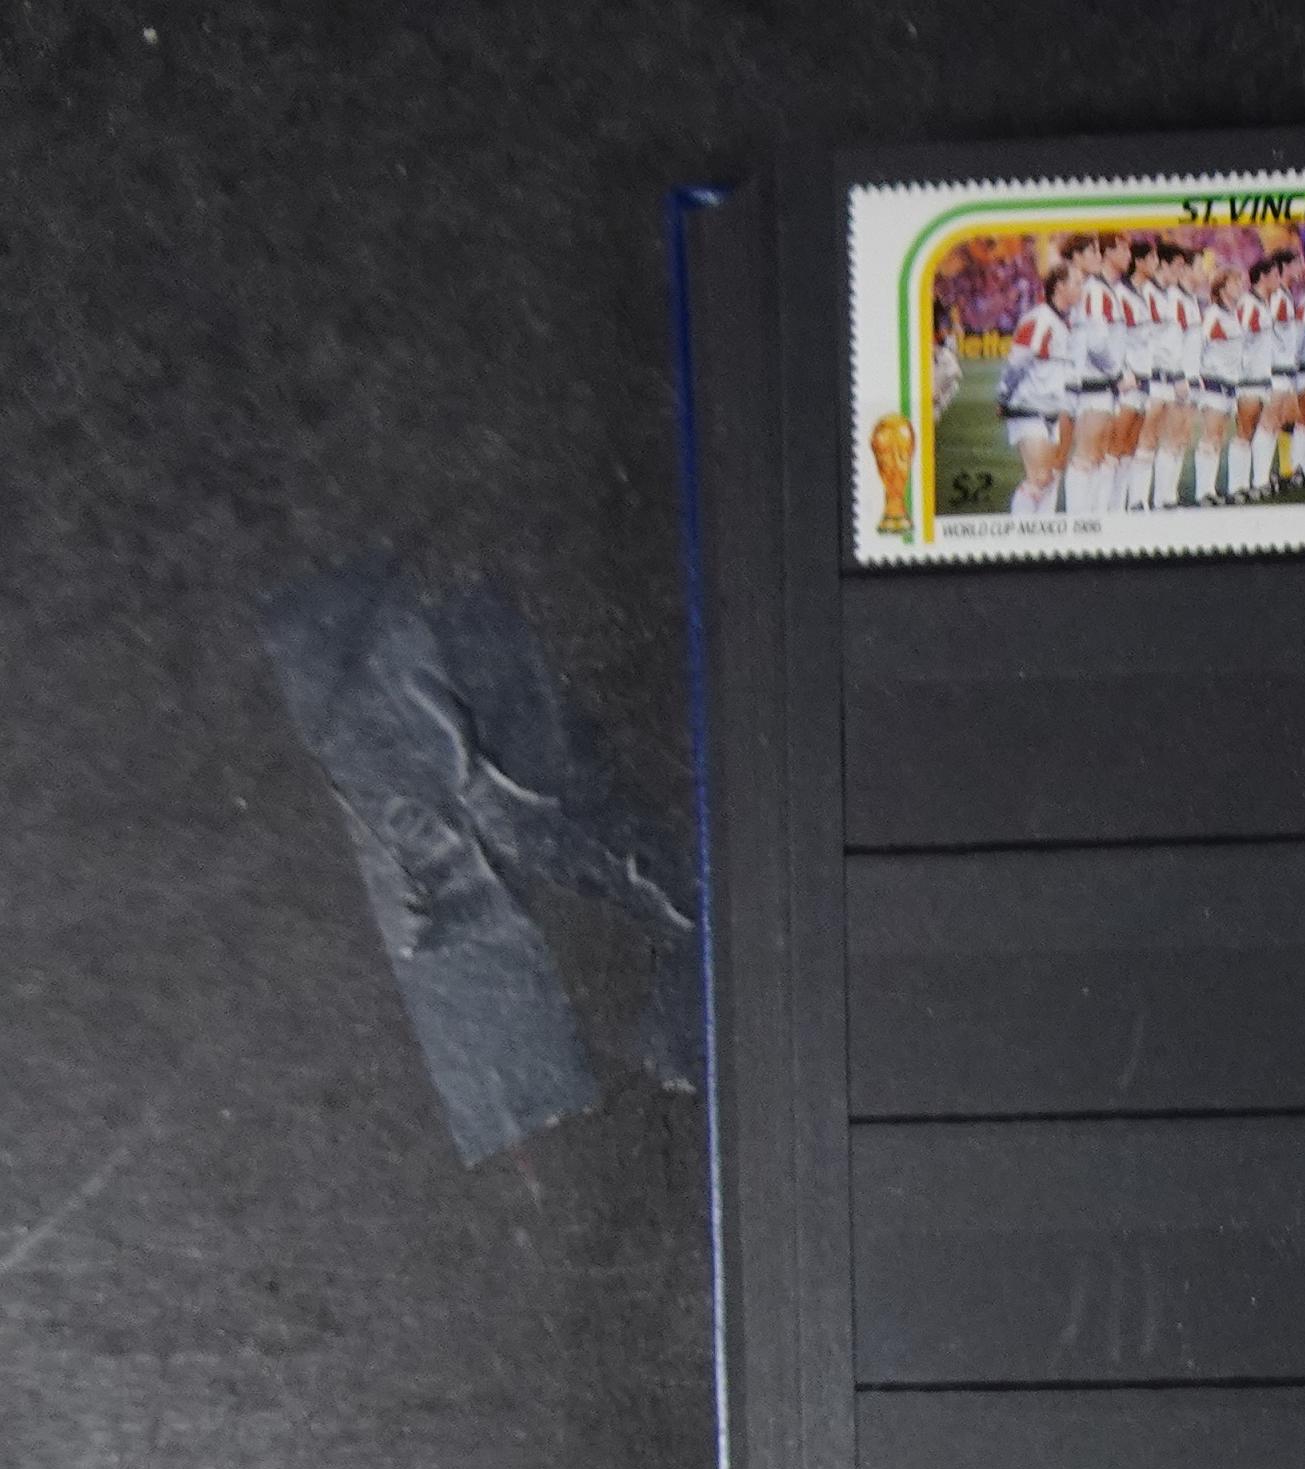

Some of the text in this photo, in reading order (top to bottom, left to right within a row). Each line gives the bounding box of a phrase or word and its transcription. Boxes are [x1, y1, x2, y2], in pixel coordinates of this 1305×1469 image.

[942, 519, 988, 538] WORLD
[989, 519, 1017, 537] CUP
[1017, 518, 1067, 536] MEXICO
